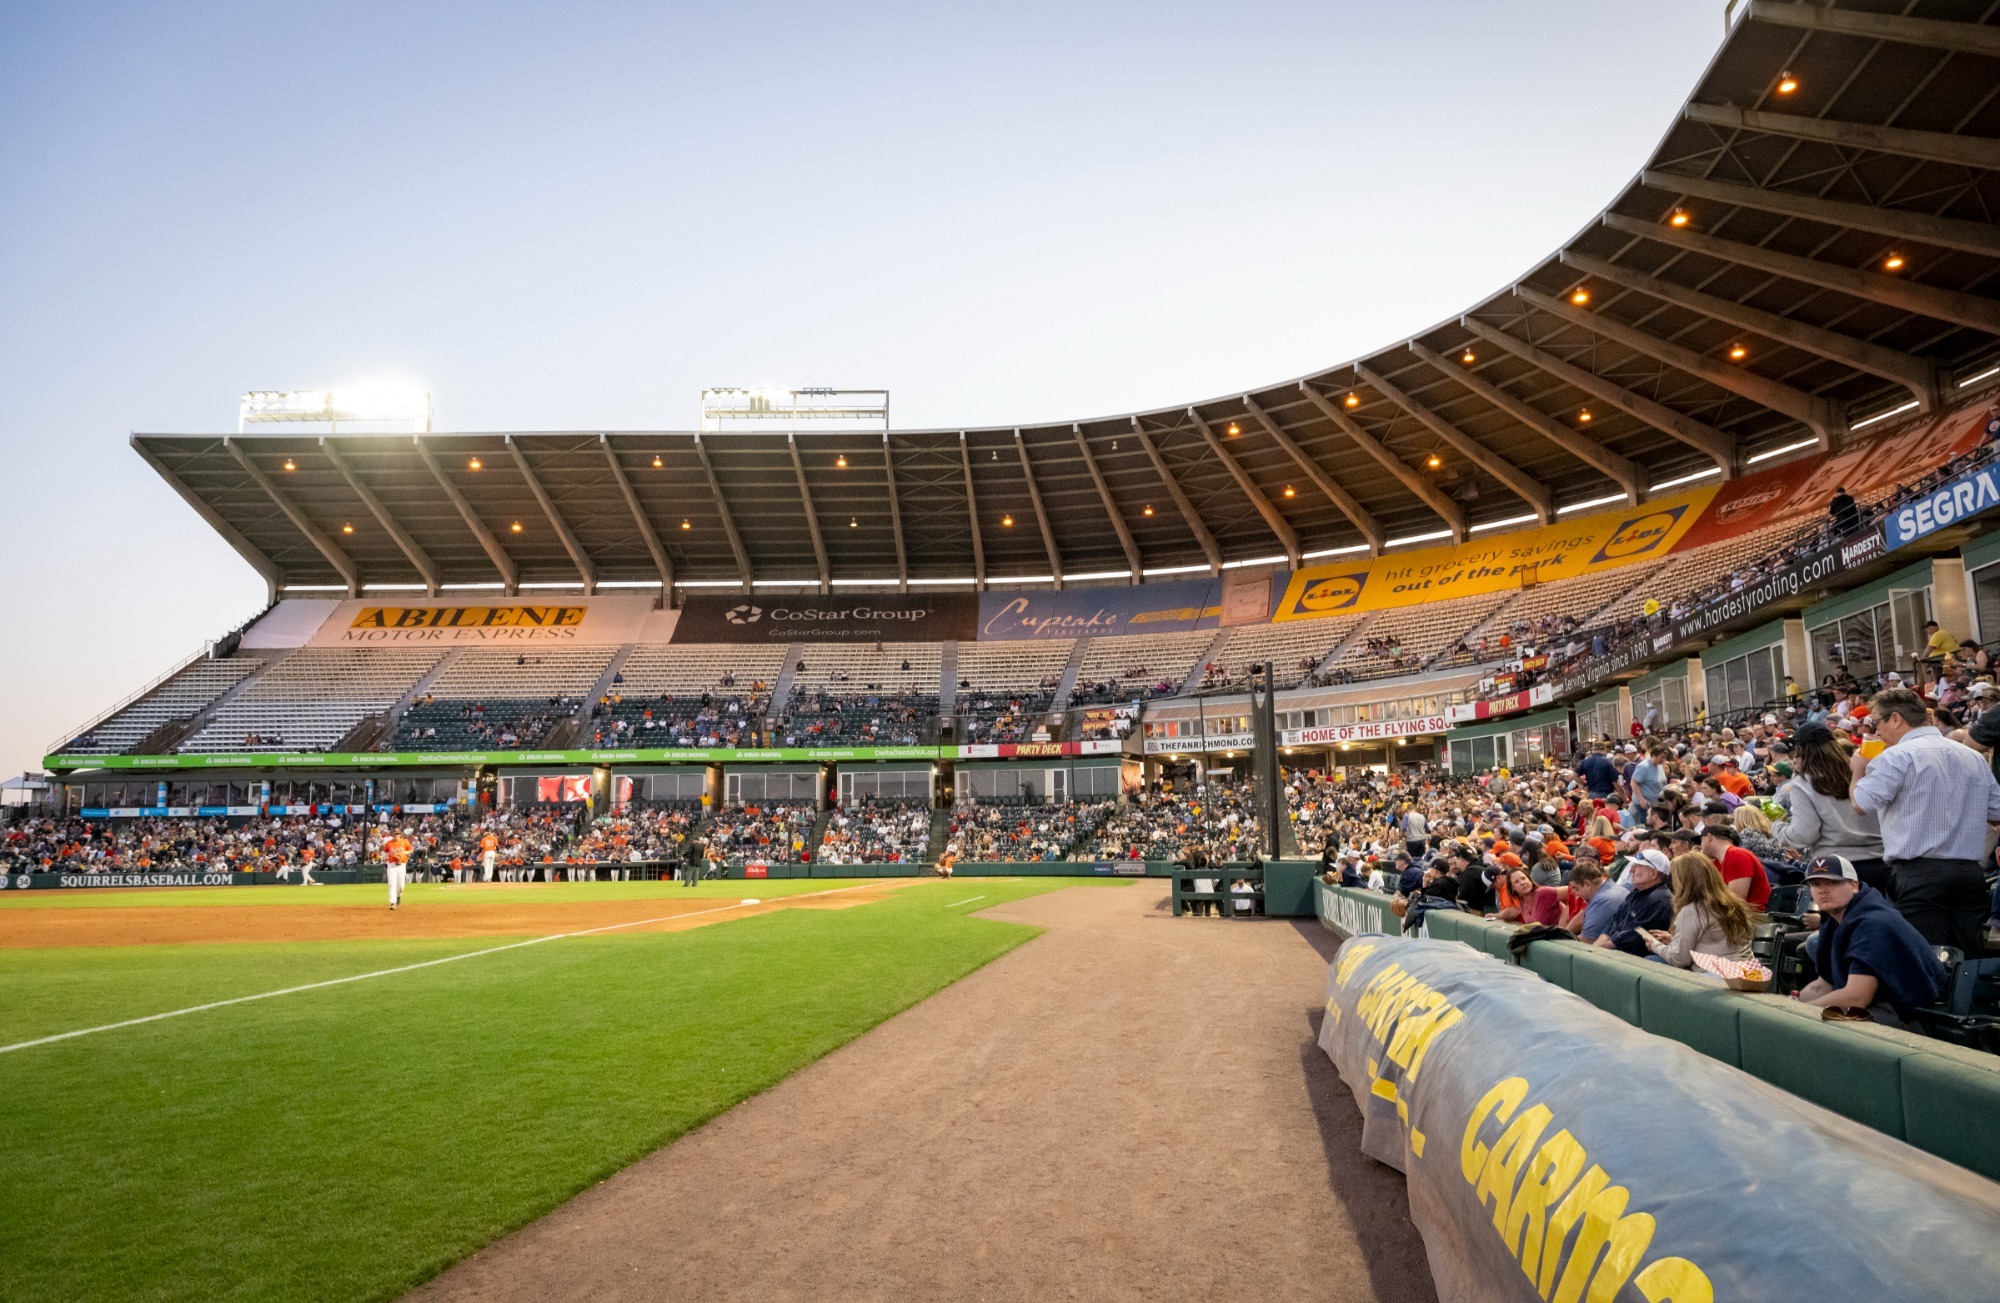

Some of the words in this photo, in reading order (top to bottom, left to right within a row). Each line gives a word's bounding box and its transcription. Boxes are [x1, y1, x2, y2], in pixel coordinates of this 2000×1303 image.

[1386, 567, 1414, 582] hit
[1419, 549, 1504, 580] grocery
[1509, 532, 1595, 559] savings
[1392, 579, 1433, 594] out
[1437, 570, 1465, 587] of
[1466, 564, 1506, 580] the
[1508, 553, 1564, 577] park
[1679, 552, 1836, 638] www.hardestyroofing.com
[355, 606, 587, 628] ABILENE
[769, 608, 850, 621] CoStar
[852, 606, 927, 621] Group
[984, 597, 1118, 637] Cupcake
[340, 629, 444, 641] MOTOR
[452, 627, 578, 640] EXPRESS
[768, 628, 882, 637] CoStarGroup.com
[1564, 674, 1586, 692] Serving
[1587, 662, 1610, 684] Virginia
[1611, 655, 1629, 673] since
[1630, 643, 1648, 662] 1990
[1489, 697, 1505, 714] PARTY
[1505, 694, 1519, 711] DECK
[1301, 728, 1337, 742] HOME
[1339, 727, 1355, 740] OF
[1358, 724, 1382, 737] THE
[1384, 719, 1426, 735] FLYING
[418, 754, 487, 762] DeltaDentalVA.com
[1015, 744, 1040, 755] PARTY
[1042, 742, 1062, 755] DECK
[18, 878, 29, 886] 34
[60, 873, 234, 888] SQUIRRELSBASEBALL.COM
